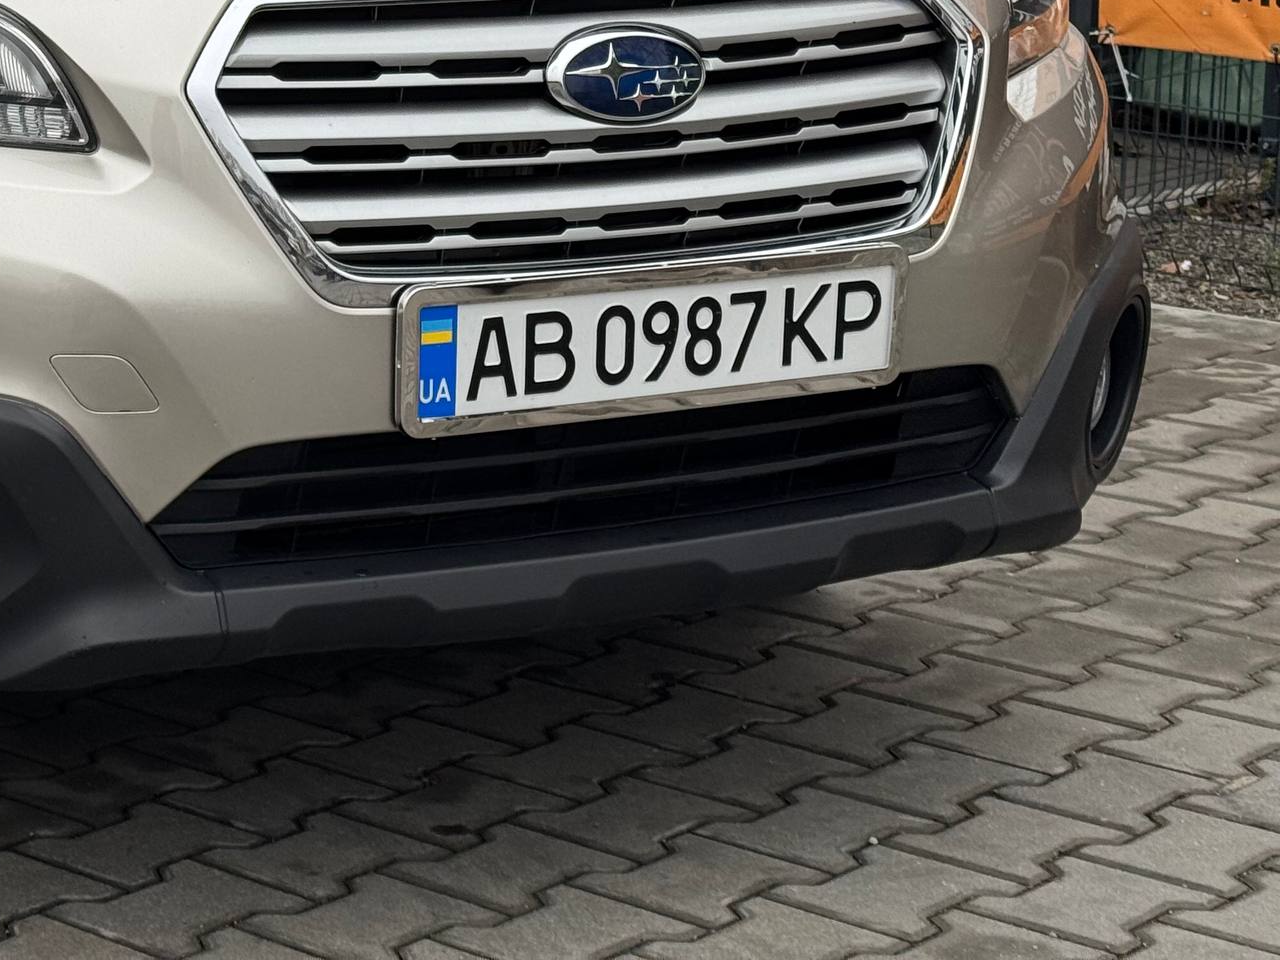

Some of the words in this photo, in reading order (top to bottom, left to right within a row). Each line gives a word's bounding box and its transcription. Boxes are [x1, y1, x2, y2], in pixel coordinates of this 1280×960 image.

[466, 311, 576, 402] AB
[596, 291, 767, 386] 0987
[782, 280, 882, 367] KP
[419, 378, 451, 404] UA
